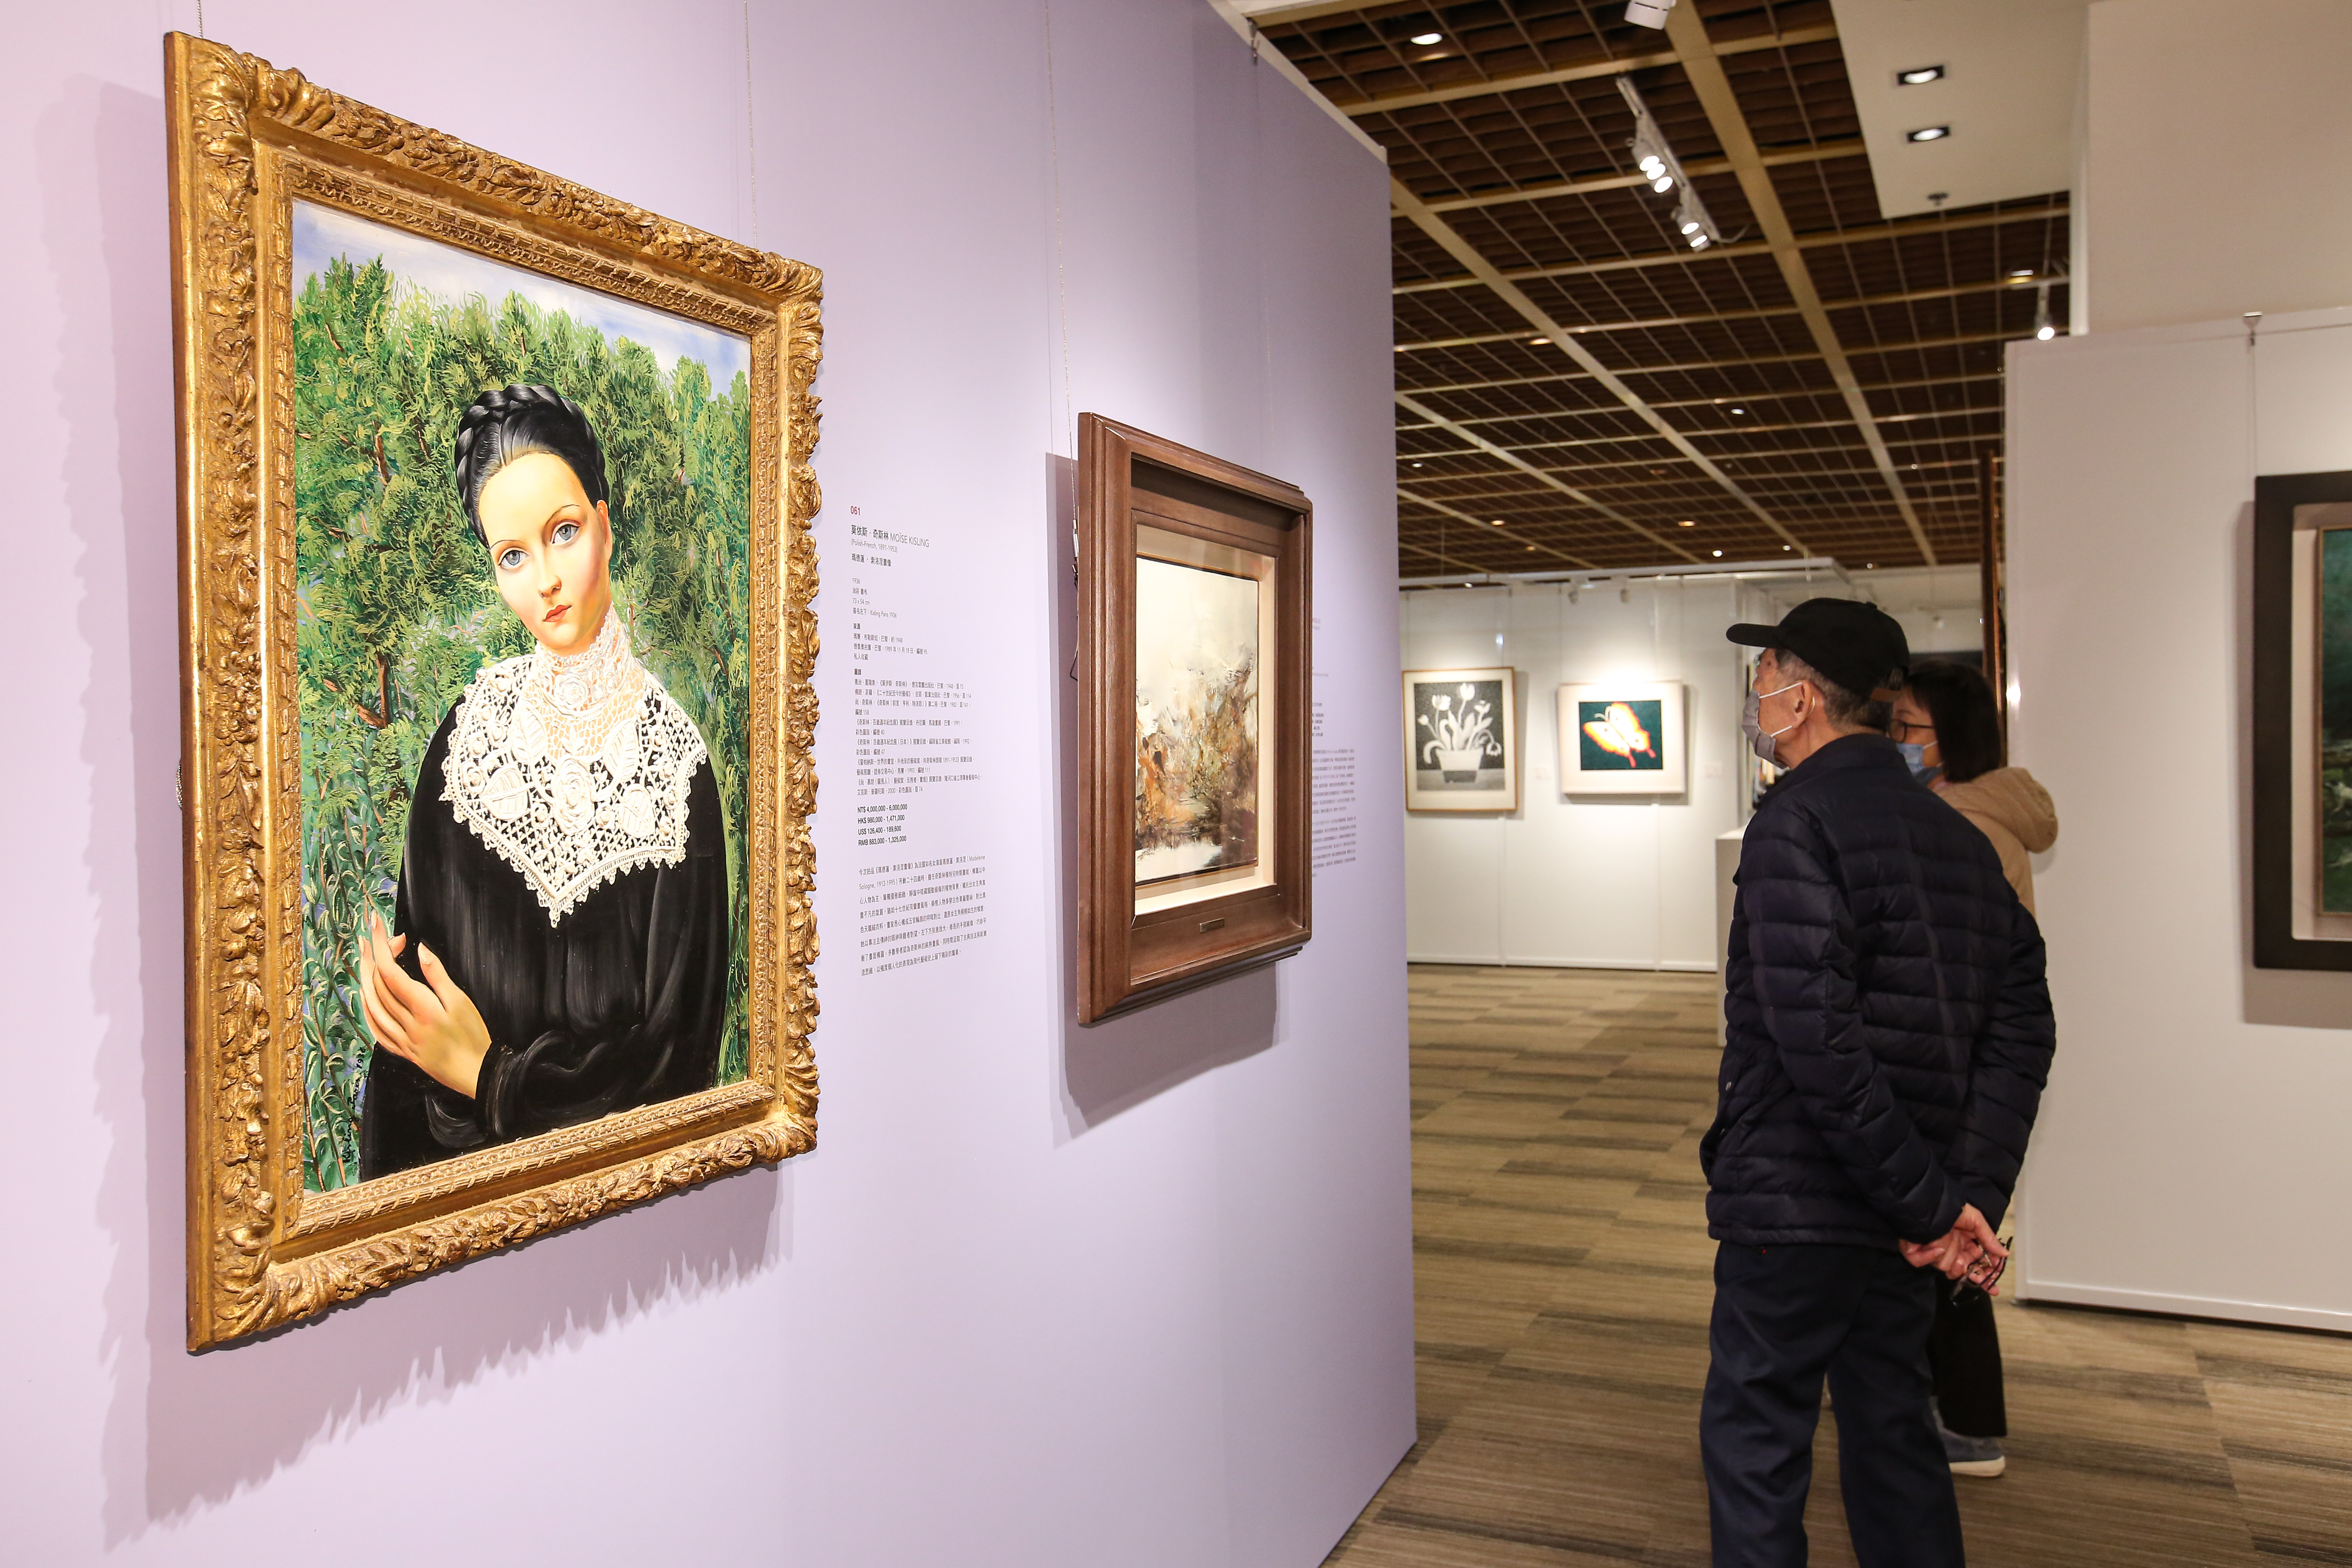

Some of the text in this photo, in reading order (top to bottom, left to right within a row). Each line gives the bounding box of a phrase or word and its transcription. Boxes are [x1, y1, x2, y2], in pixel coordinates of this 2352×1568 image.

[851, 506, 860, 515] 061
[851, 539, 898, 553] (Polish-French, 1891-1953)
[891, 532, 907, 543] MOÏSE
[909, 536, 929, 547] KISLING
